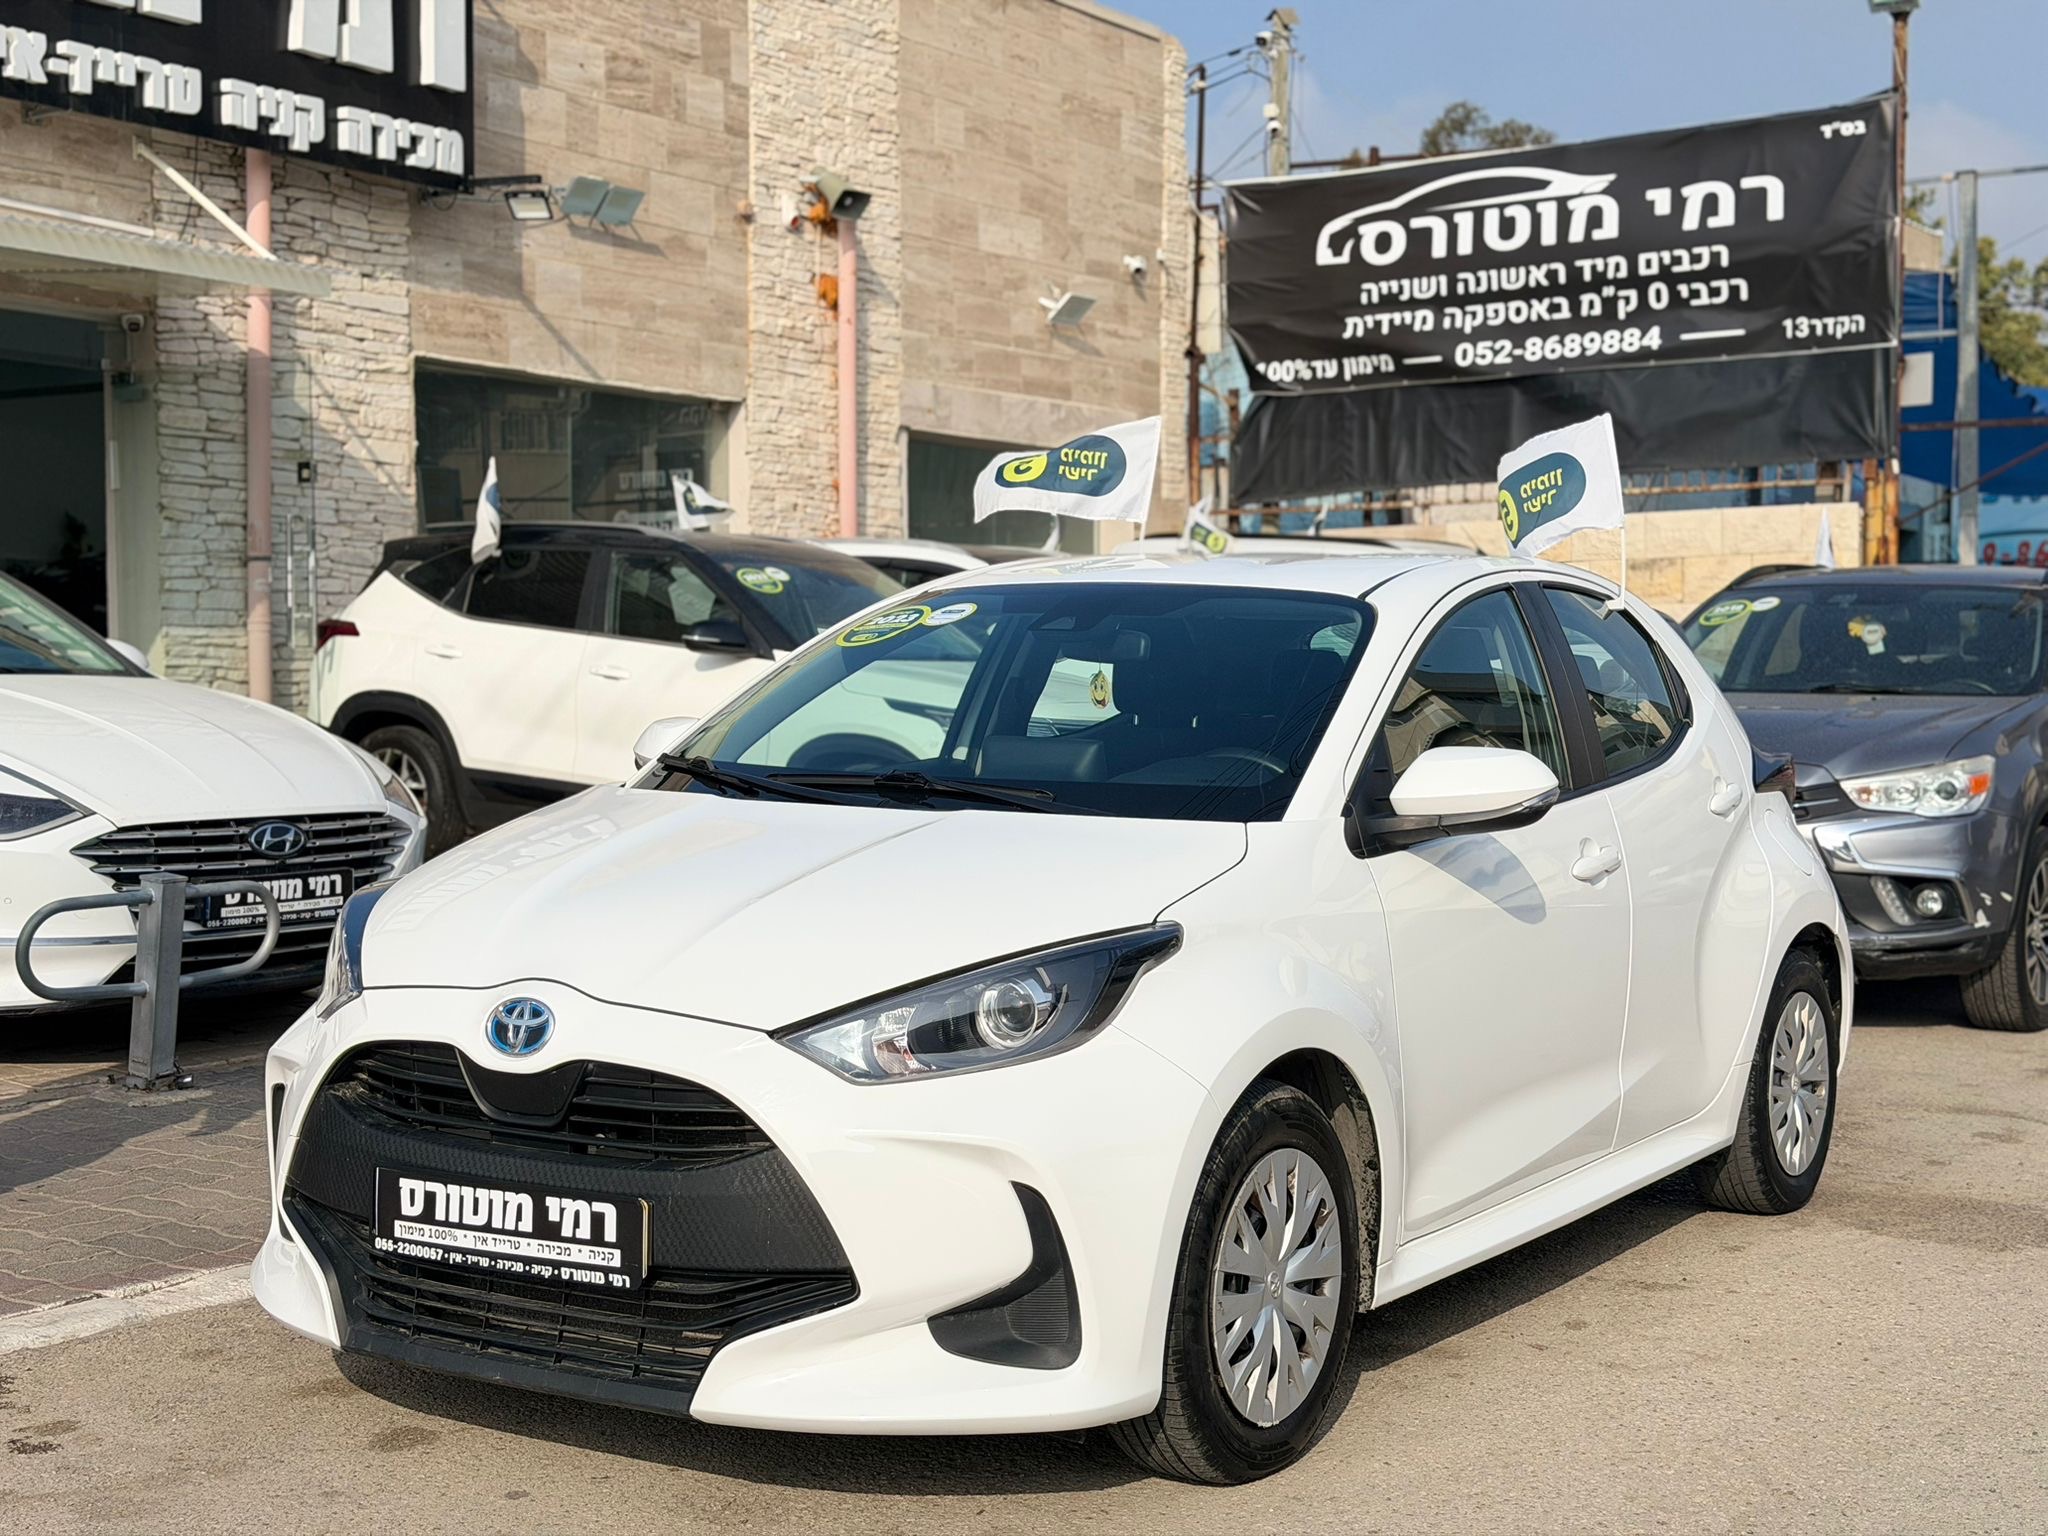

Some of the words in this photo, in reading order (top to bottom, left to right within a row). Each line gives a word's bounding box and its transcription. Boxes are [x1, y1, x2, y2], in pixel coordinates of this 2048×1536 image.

[220, 78, 325, 152] קניה
[337, 105, 464, 176] מכירה
[1646, 175, 1785, 231] רמי
[1358, 194, 1620, 266] מוטורס
[1574, 255, 1628, 282] מיד
[1638, 244, 1730, 277] רכבים
[1360, 274, 1448, 305] ושנייה
[1456, 262, 1567, 296] ראשונה
[1676, 278, 1749, 306] רכבי
[1579, 285, 1638, 320] ק"מ
[1647, 281, 1669, 310] 0
[1342, 309, 1434, 339] מיידית
[1442, 296, 1572, 334] באספקה
[1455, 325, 1662, 367] 052-8689884
[1342, 354, 1395, 381] מימון
[308, 874, 342, 896] רמי
[399, 1177, 533, 1233] מוטורס
[399, 1224, 425, 1237] מימון
[545, 1196, 617, 1242] רמי
[374, 1237, 443, 1260] 055-2200057
[428, 1228, 458, 1242] 100%
[473, 1235, 488, 1248] אין
[491, 1237, 521, 1250] טרייד
[449, 1251, 489, 1266] טרייד-אין
[537, 1243, 571, 1257] מכירה
[588, 1249, 615, 1264] קניה
[496, 1259, 523, 1272] מכירה
[531, 1264, 552, 1278] קניה
[560, 1267, 605, 1284] מוטורס
[608, 1273, 630, 1288] רמי
